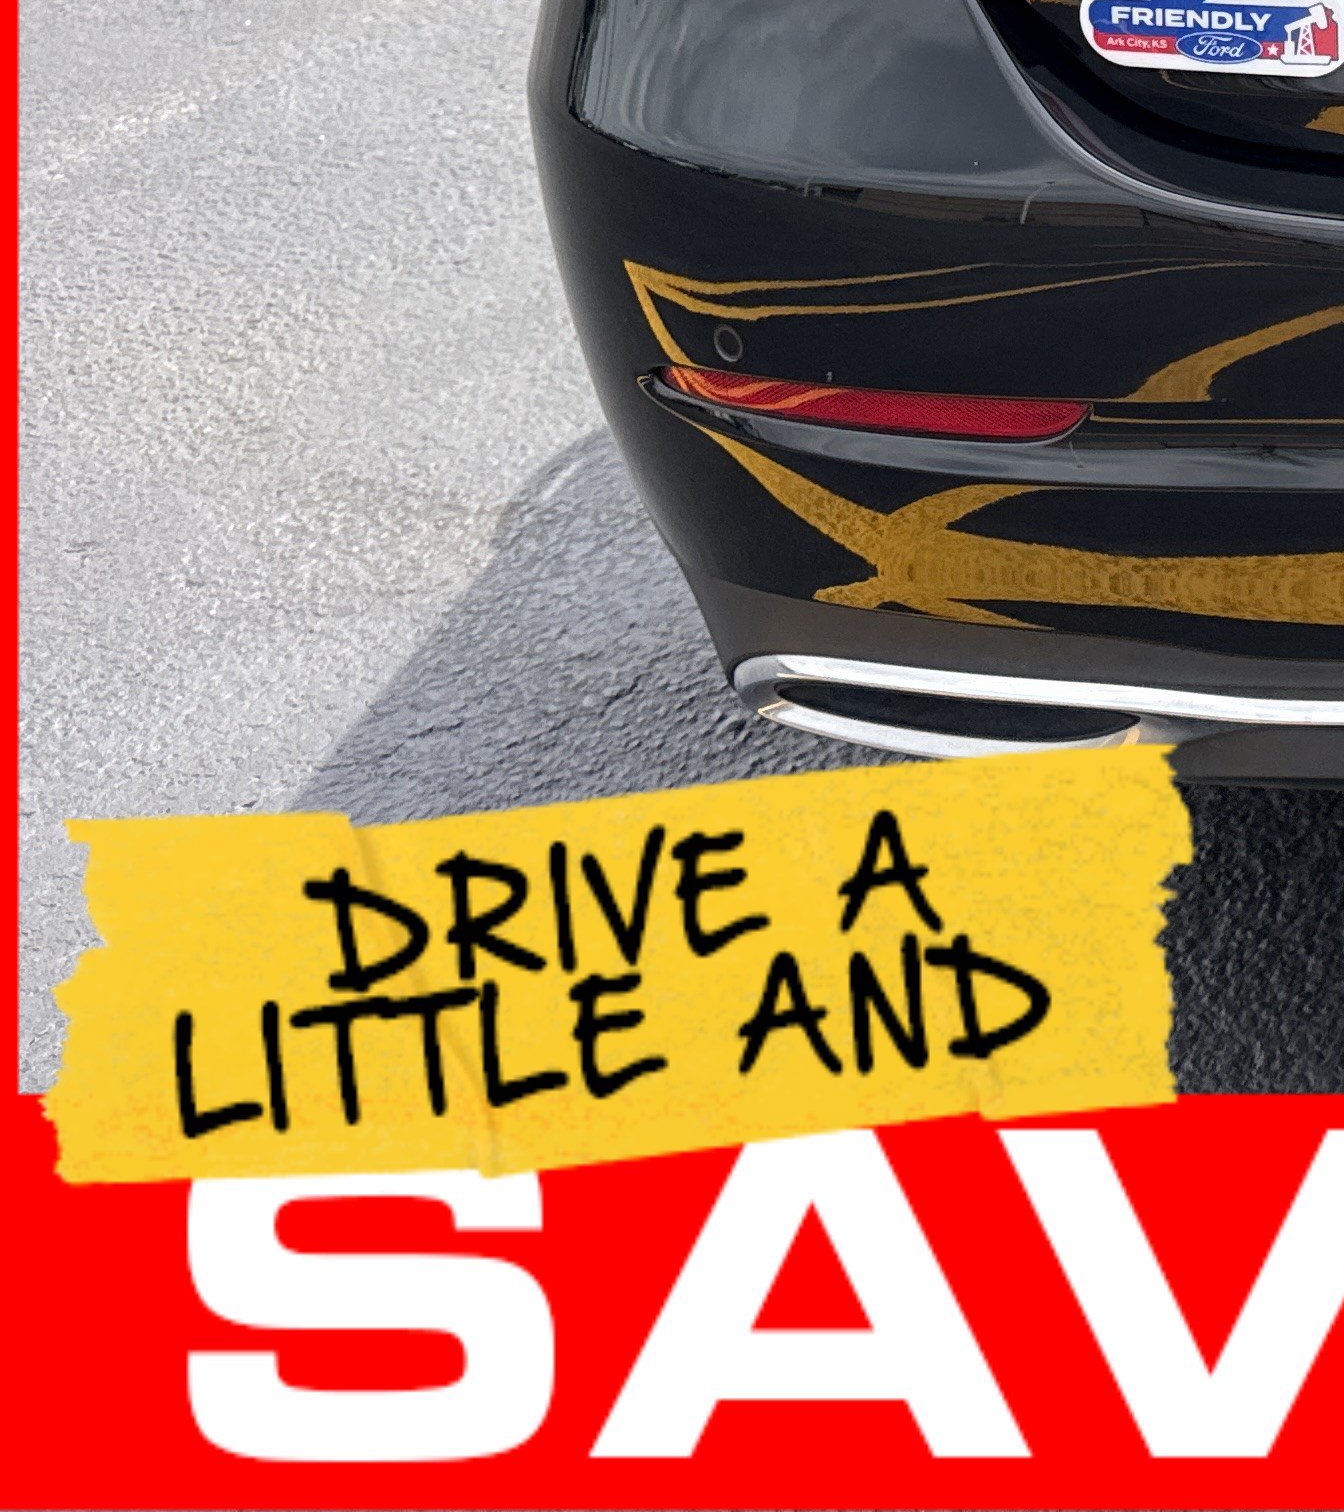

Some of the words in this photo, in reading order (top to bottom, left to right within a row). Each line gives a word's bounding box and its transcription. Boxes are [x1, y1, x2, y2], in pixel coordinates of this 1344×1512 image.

[1111, 5, 1272, 32] FRIENDLY
[1107, 36, 1125, 47] Ark
[1151, 39, 1168, 49] KS
[1193, 35, 1246, 59] Ford
